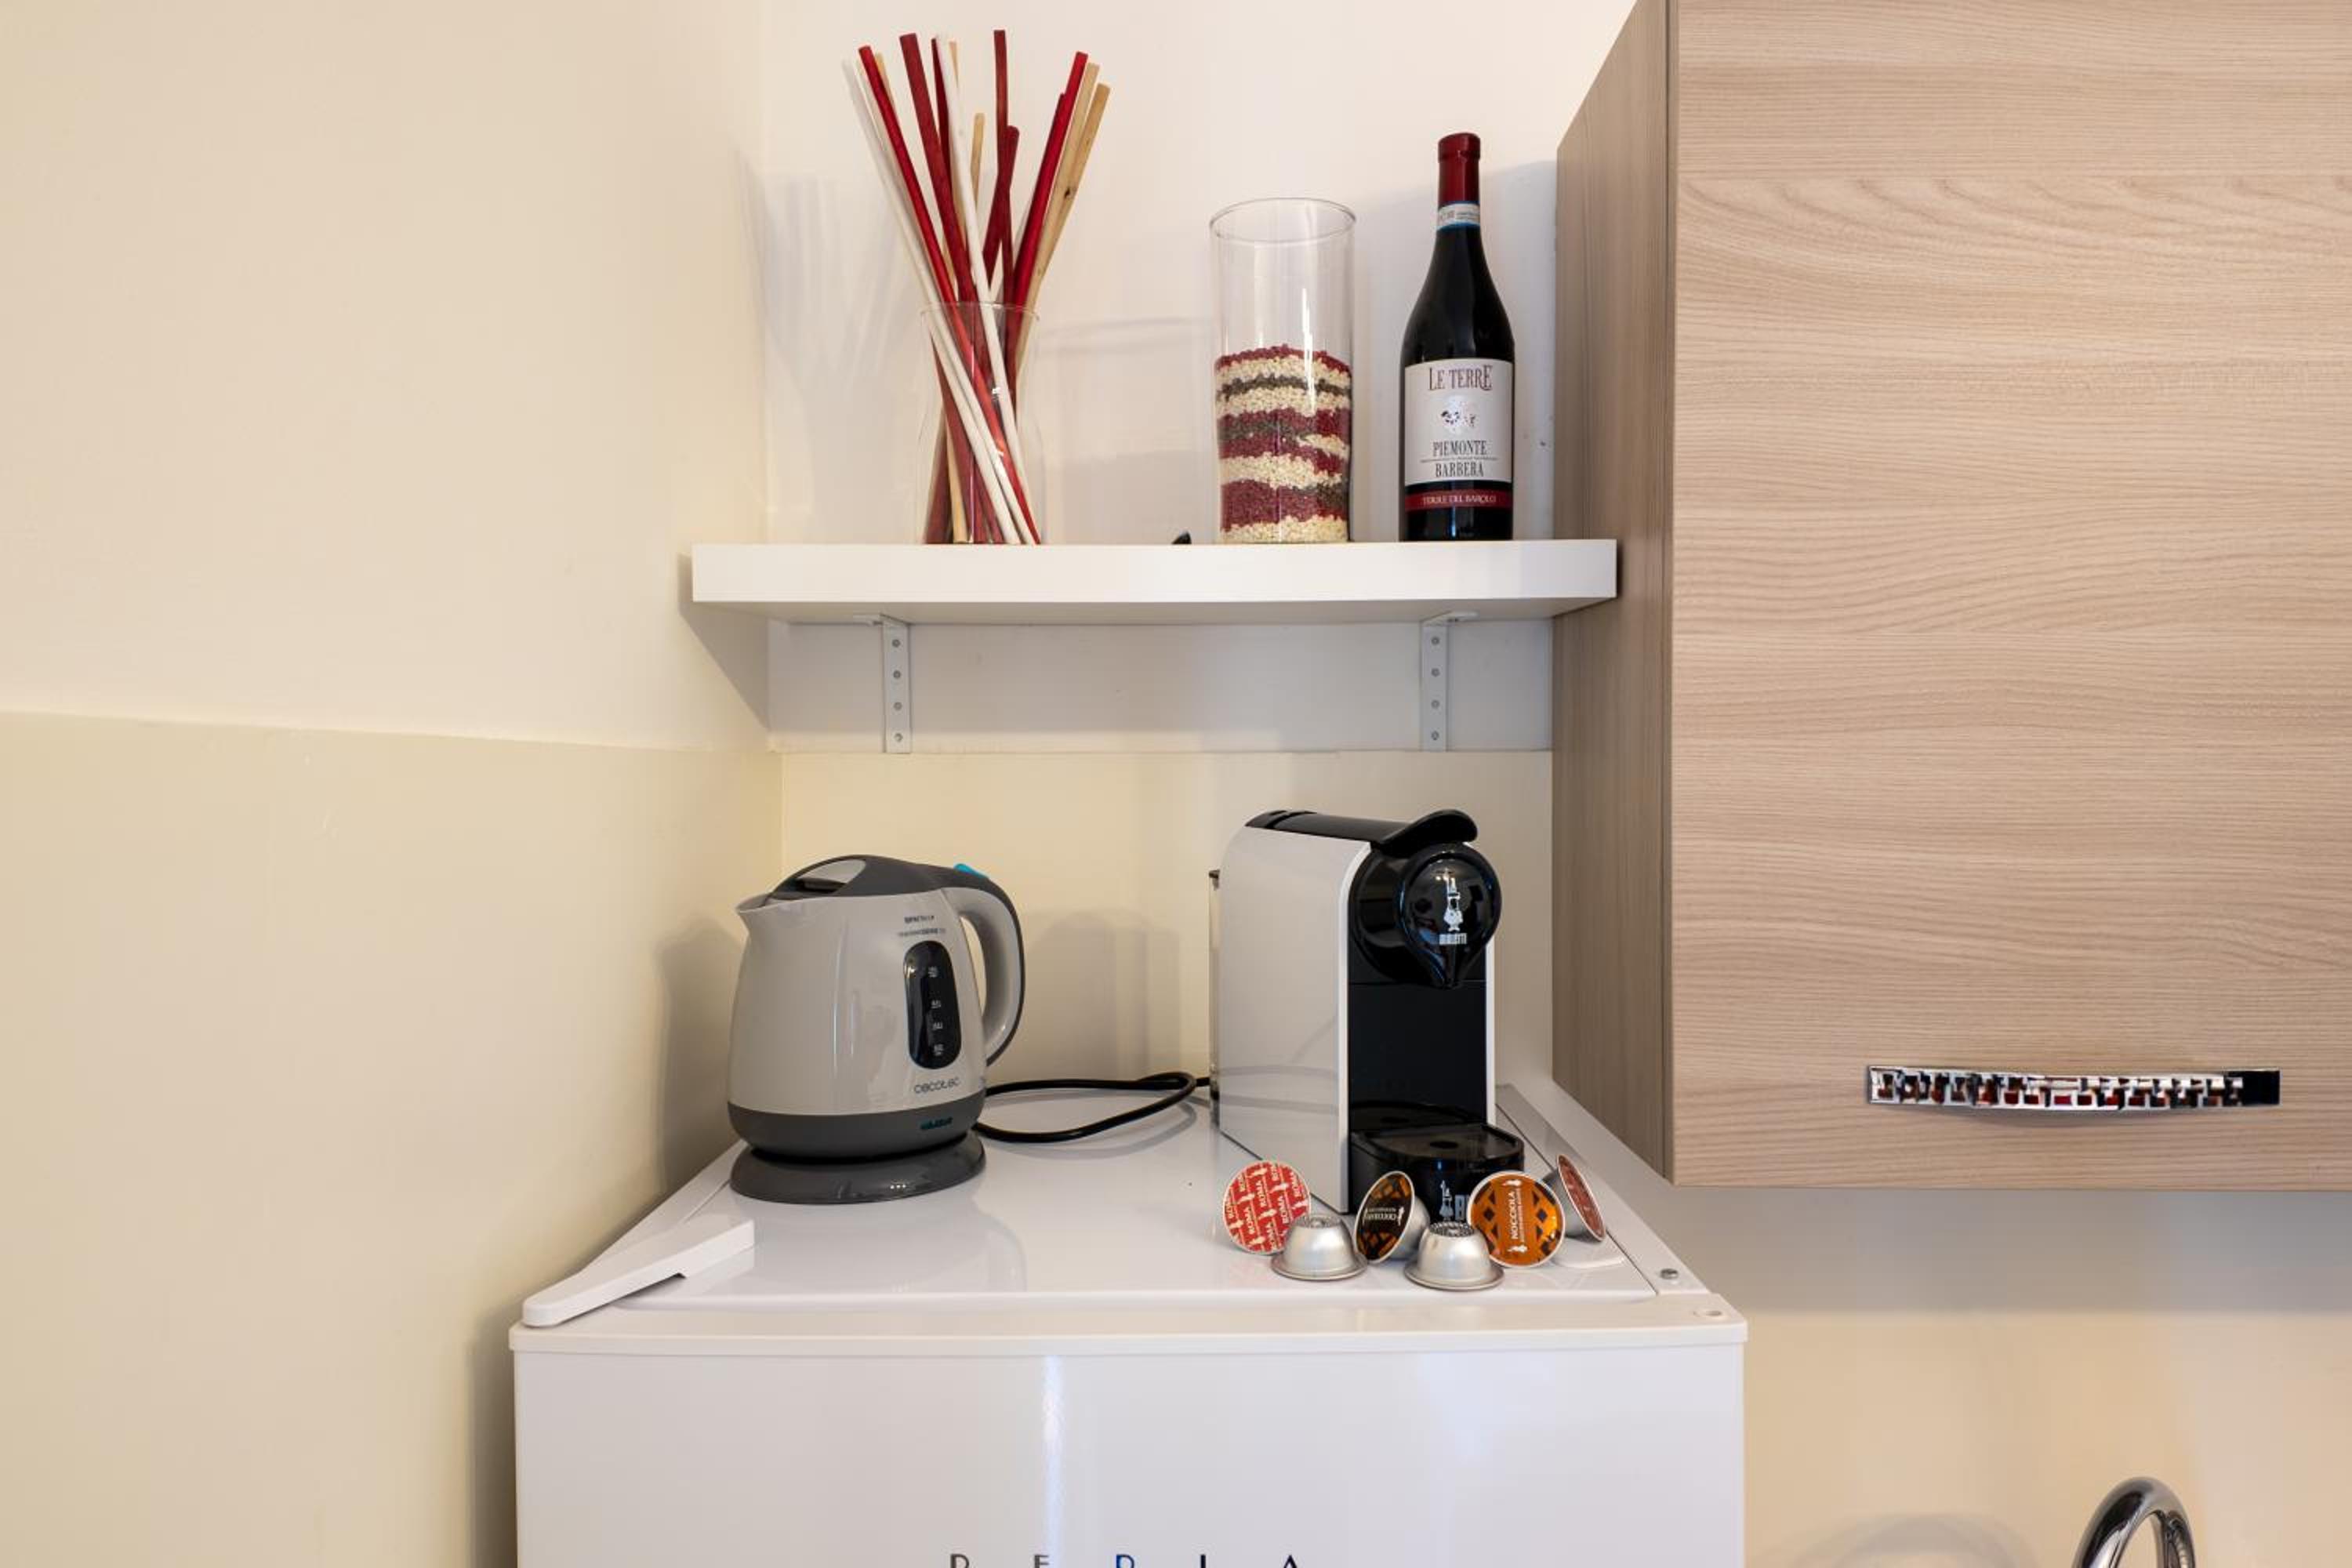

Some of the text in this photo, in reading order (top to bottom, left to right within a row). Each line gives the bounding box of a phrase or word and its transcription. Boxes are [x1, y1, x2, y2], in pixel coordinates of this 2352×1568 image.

[1429, 365, 1493, 391] LE TERRE
[1432, 440, 1487, 456] PIEMONTE
[1436, 462, 1484, 477] BARBERA
[1256, 1180, 1268, 1208] ROMA
[1244, 1206, 1256, 1235] ROMA
[1278, 1196, 1290, 1224] ROMA
[1508, 1190, 1519, 1240] NOCCIOLA
